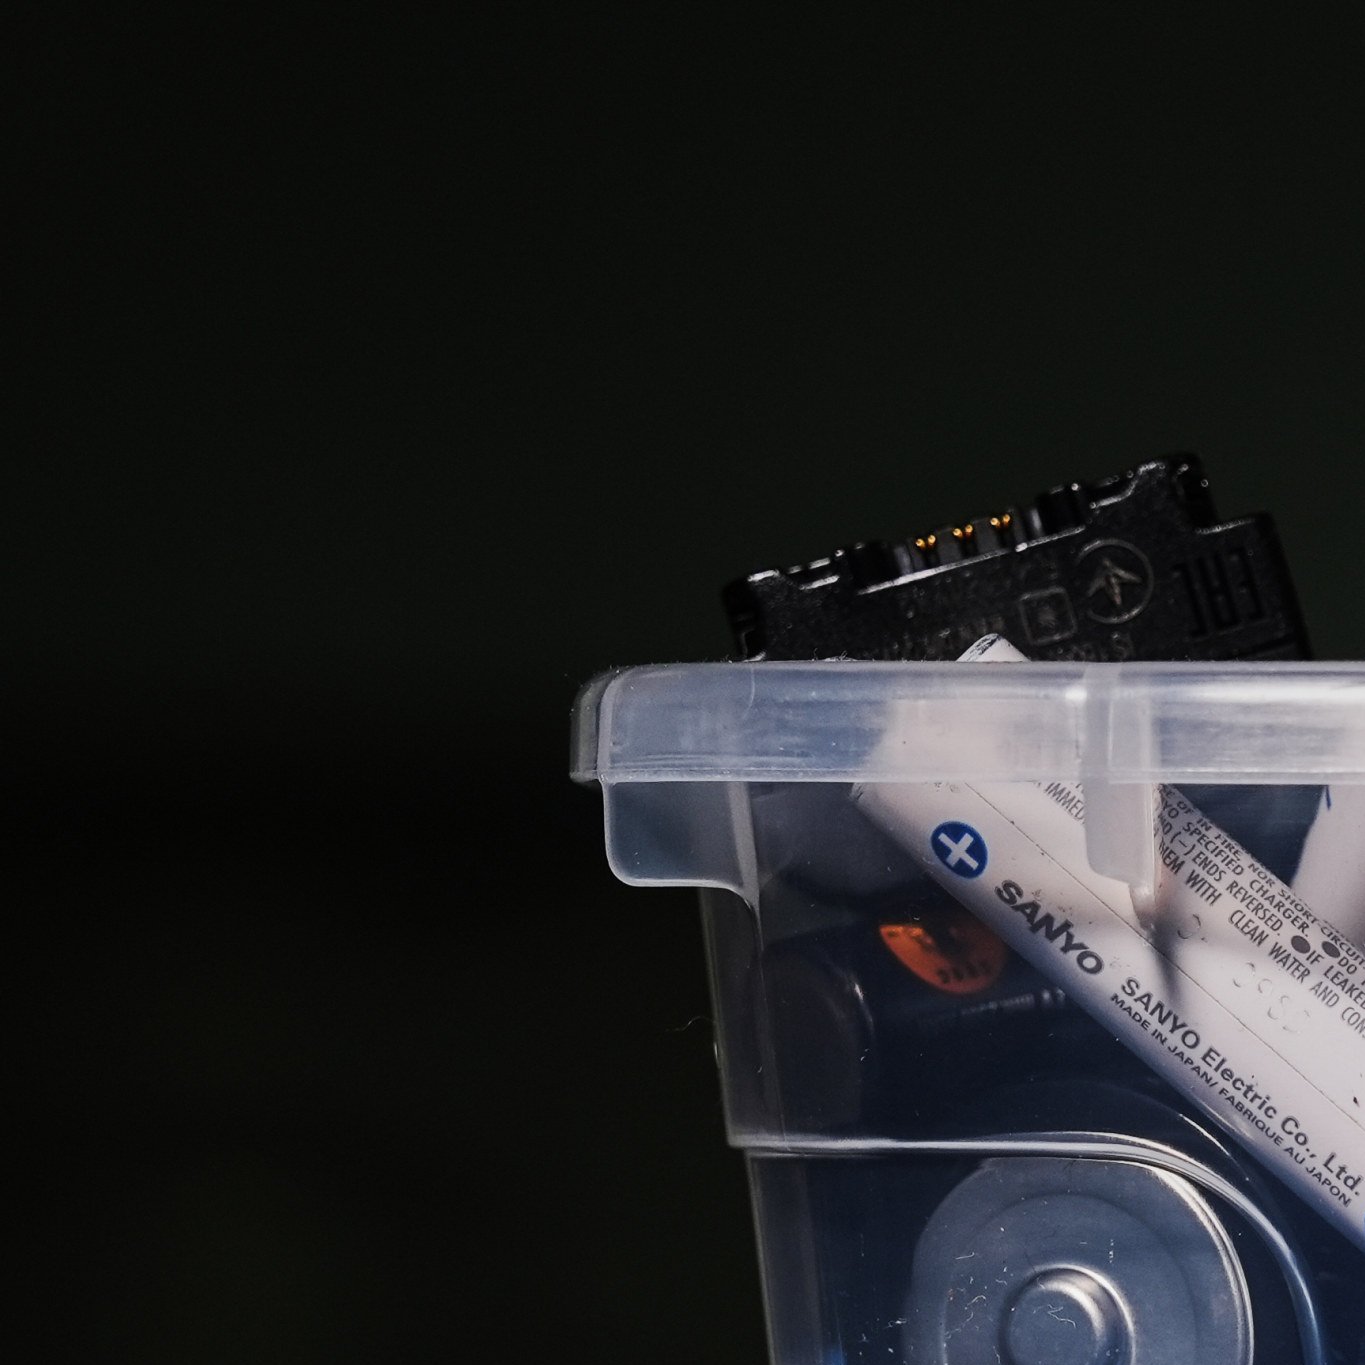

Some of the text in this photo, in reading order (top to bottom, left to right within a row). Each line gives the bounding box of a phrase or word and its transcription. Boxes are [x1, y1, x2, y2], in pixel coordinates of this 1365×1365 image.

[992, 876, 1107, 979] SANYO
[1180, 820, 1247, 878] SPECIFIED
[1247, 877, 1313, 939] CHARGER.
[1335, 954, 1359, 977] DO
[1183, 868, 1224, 907] WITH
[1227, 907, 1271, 949] CLEAN
[1266, 940, 1313, 985] WATER
[1308, 979, 1342, 1010] AND
[1190, 849, 1228, 884] ENDS
[1224, 878, 1286, 938] REVERSED.
[1108, 992, 1153, 1033] MADE
[1149, 1027, 1169, 1047] IN
[1216, 1086, 1285, 1148] FABRIQUE
[1281, 1144, 1307, 1167] AU
[1303, 1164, 1353, 1208] JAPON
[1118, 976, 1365, 1198] SANYO Electric Co., Ltd.
